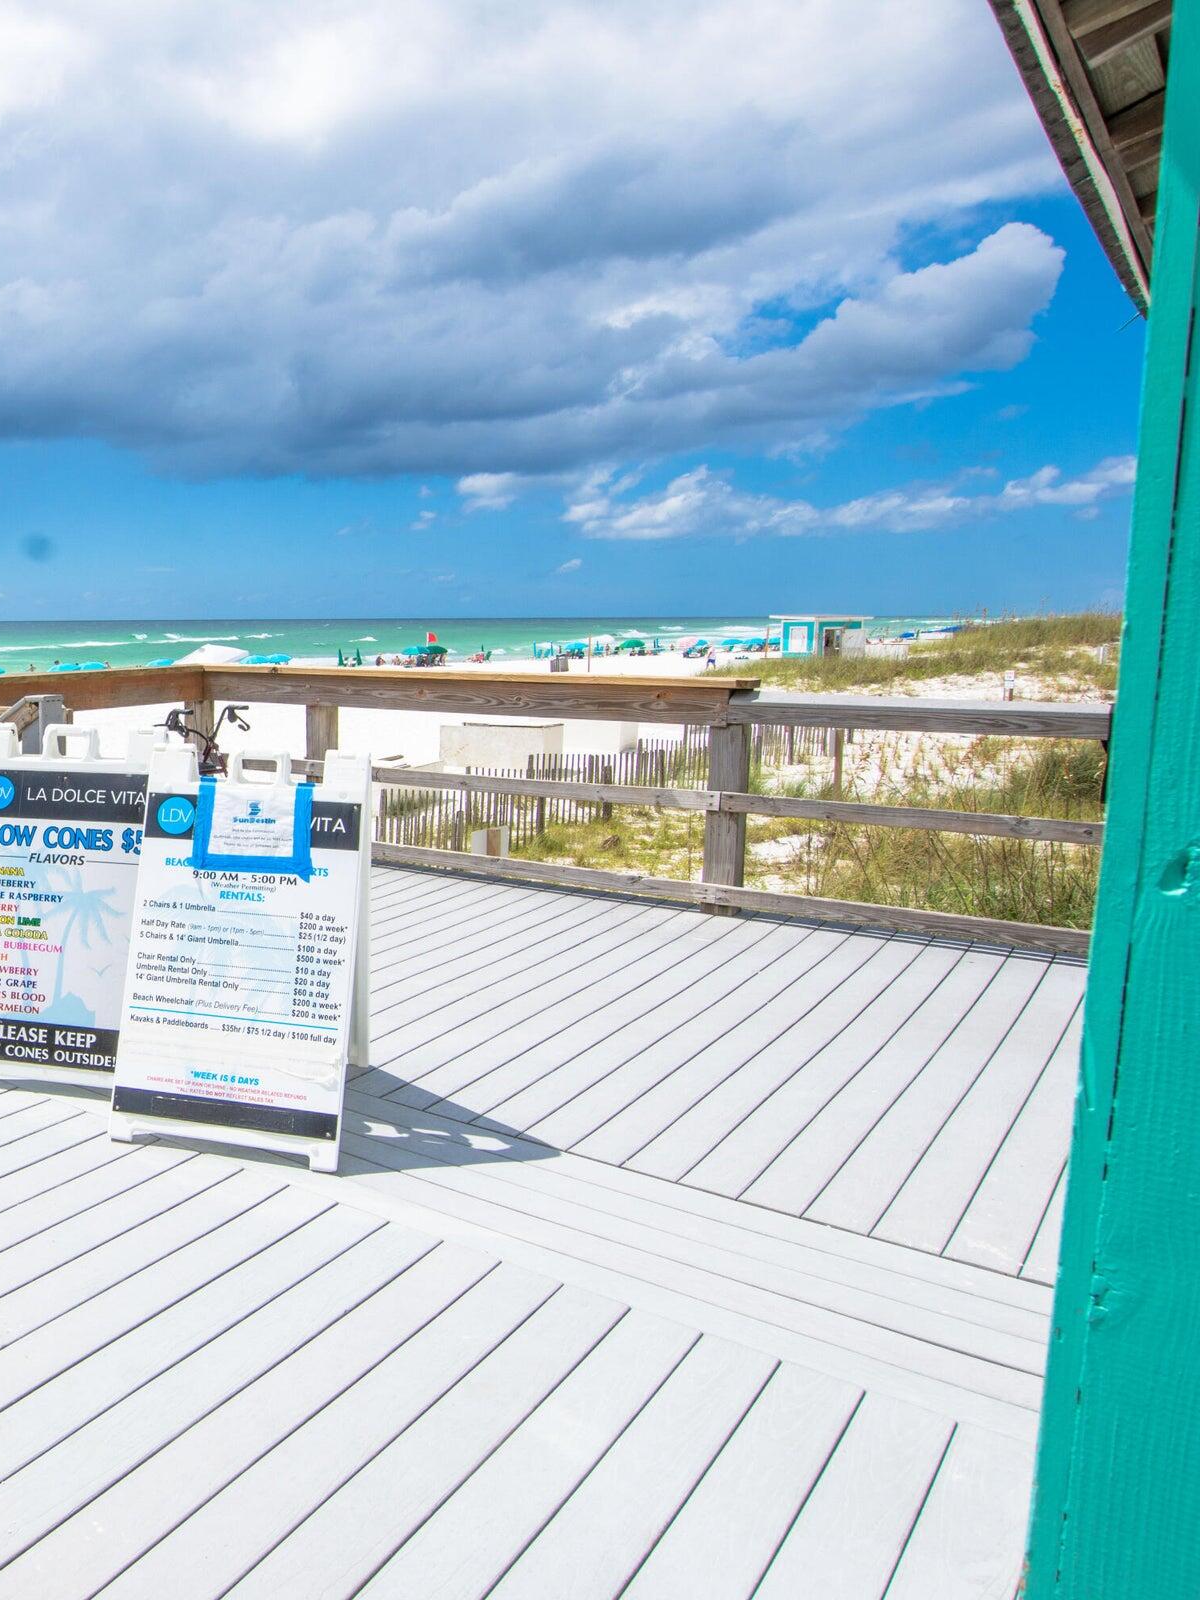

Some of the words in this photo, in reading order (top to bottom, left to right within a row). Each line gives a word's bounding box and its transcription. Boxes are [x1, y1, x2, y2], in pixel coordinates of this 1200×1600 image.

[27, 787, 47, 802] LA
[51, 788, 106, 805] DOLCE
[111, 790, 146, 806] VITA
[161, 808, 193, 823] LDV
[43, 826, 113, 851] CONES
[28, 853, 85, 866] FLAVORS
[165, 857, 192, 868] BEAC
[192, 870, 216, 880] 9:00
[220, 871, 239, 882] AM
[251, 874, 276, 884] 5:00
[279, 876, 298, 886] PM
[211, 880, 239, 890] (Weather
[241, 883, 276, 893] Permitting)
[8, 892, 64, 903] RASPBERRY
[219, 891, 266, 902] RENTALS:
[149, 900, 170, 909] Chairs
[185, 902, 216, 912] Umbrella
[17, 916, 41, 927] LIME
[300, 912, 313, 920] $40
[323, 913, 336, 923] day
[141, 919, 153, 928] Half
[155, 920, 169, 930] Day
[171, 921, 186, 929] Rate
[299, 922, 317, 931] $200
[4, 928, 49, 940] COLODA
[145, 931, 167, 940] Chairs
[187, 934, 206, 944] Giant
[299, 932, 312, 941] $25
[3, 941, 64, 953] BUBBLEGUM
[297, 945, 314, 954] $100
[324, 947, 337, 956] day
[137, 952, 155, 961] Chair
[157, 953, 178, 963] Rental
[180, 955, 196, 965] Only
[296, 955, 314, 964] $500
[136, 962, 166, 972] Umbrella
[168, 964, 189, 974] Rental
[191, 967, 207, 977] Only
[295, 967, 308, 975] $10
[318, 968, 331, 978] day
[5, 979, 38, 989] GRAPE
[146, 974, 164, 983] Giant
[166, 975, 197, 986] Umbrella
[199, 978, 221, 988] Rental
[223, 980, 239, 990] Only
[294, 977, 307, 986] $20
[317, 979, 330, 989] day
[10, 991, 46, 1003] BLOOD
[316, 990, 329, 1000] day
[133, 992, 153, 1002] Beach
[155, 994, 194, 1006] Wheelchair
[195, 997, 212, 1008] (Plus
[214, 999, 240, 1012] Delivery
[292, 999, 310, 1008] $200
[291, 1009, 309, 1019] $200
[162, 1017, 209, 1030] Paddleboards
[221, 1023, 241, 1033] $35hr
[247, 1026, 259, 1036] $75
[261, 1027, 272, 1037] 1/2
[272, 1029, 285, 1040] day
[291, 1031, 309, 1041] $100
[310, 1033, 322, 1043] full
[323, 1035, 337, 1045] day
[54, 1030, 97, 1049] KEEP
[5, 1044, 49, 1060] CONES
[54, 1051, 116, 1067] OUTSIDE!
[220, 1074, 229, 1083] IS
[238, 1076, 259, 1086] DAYS
